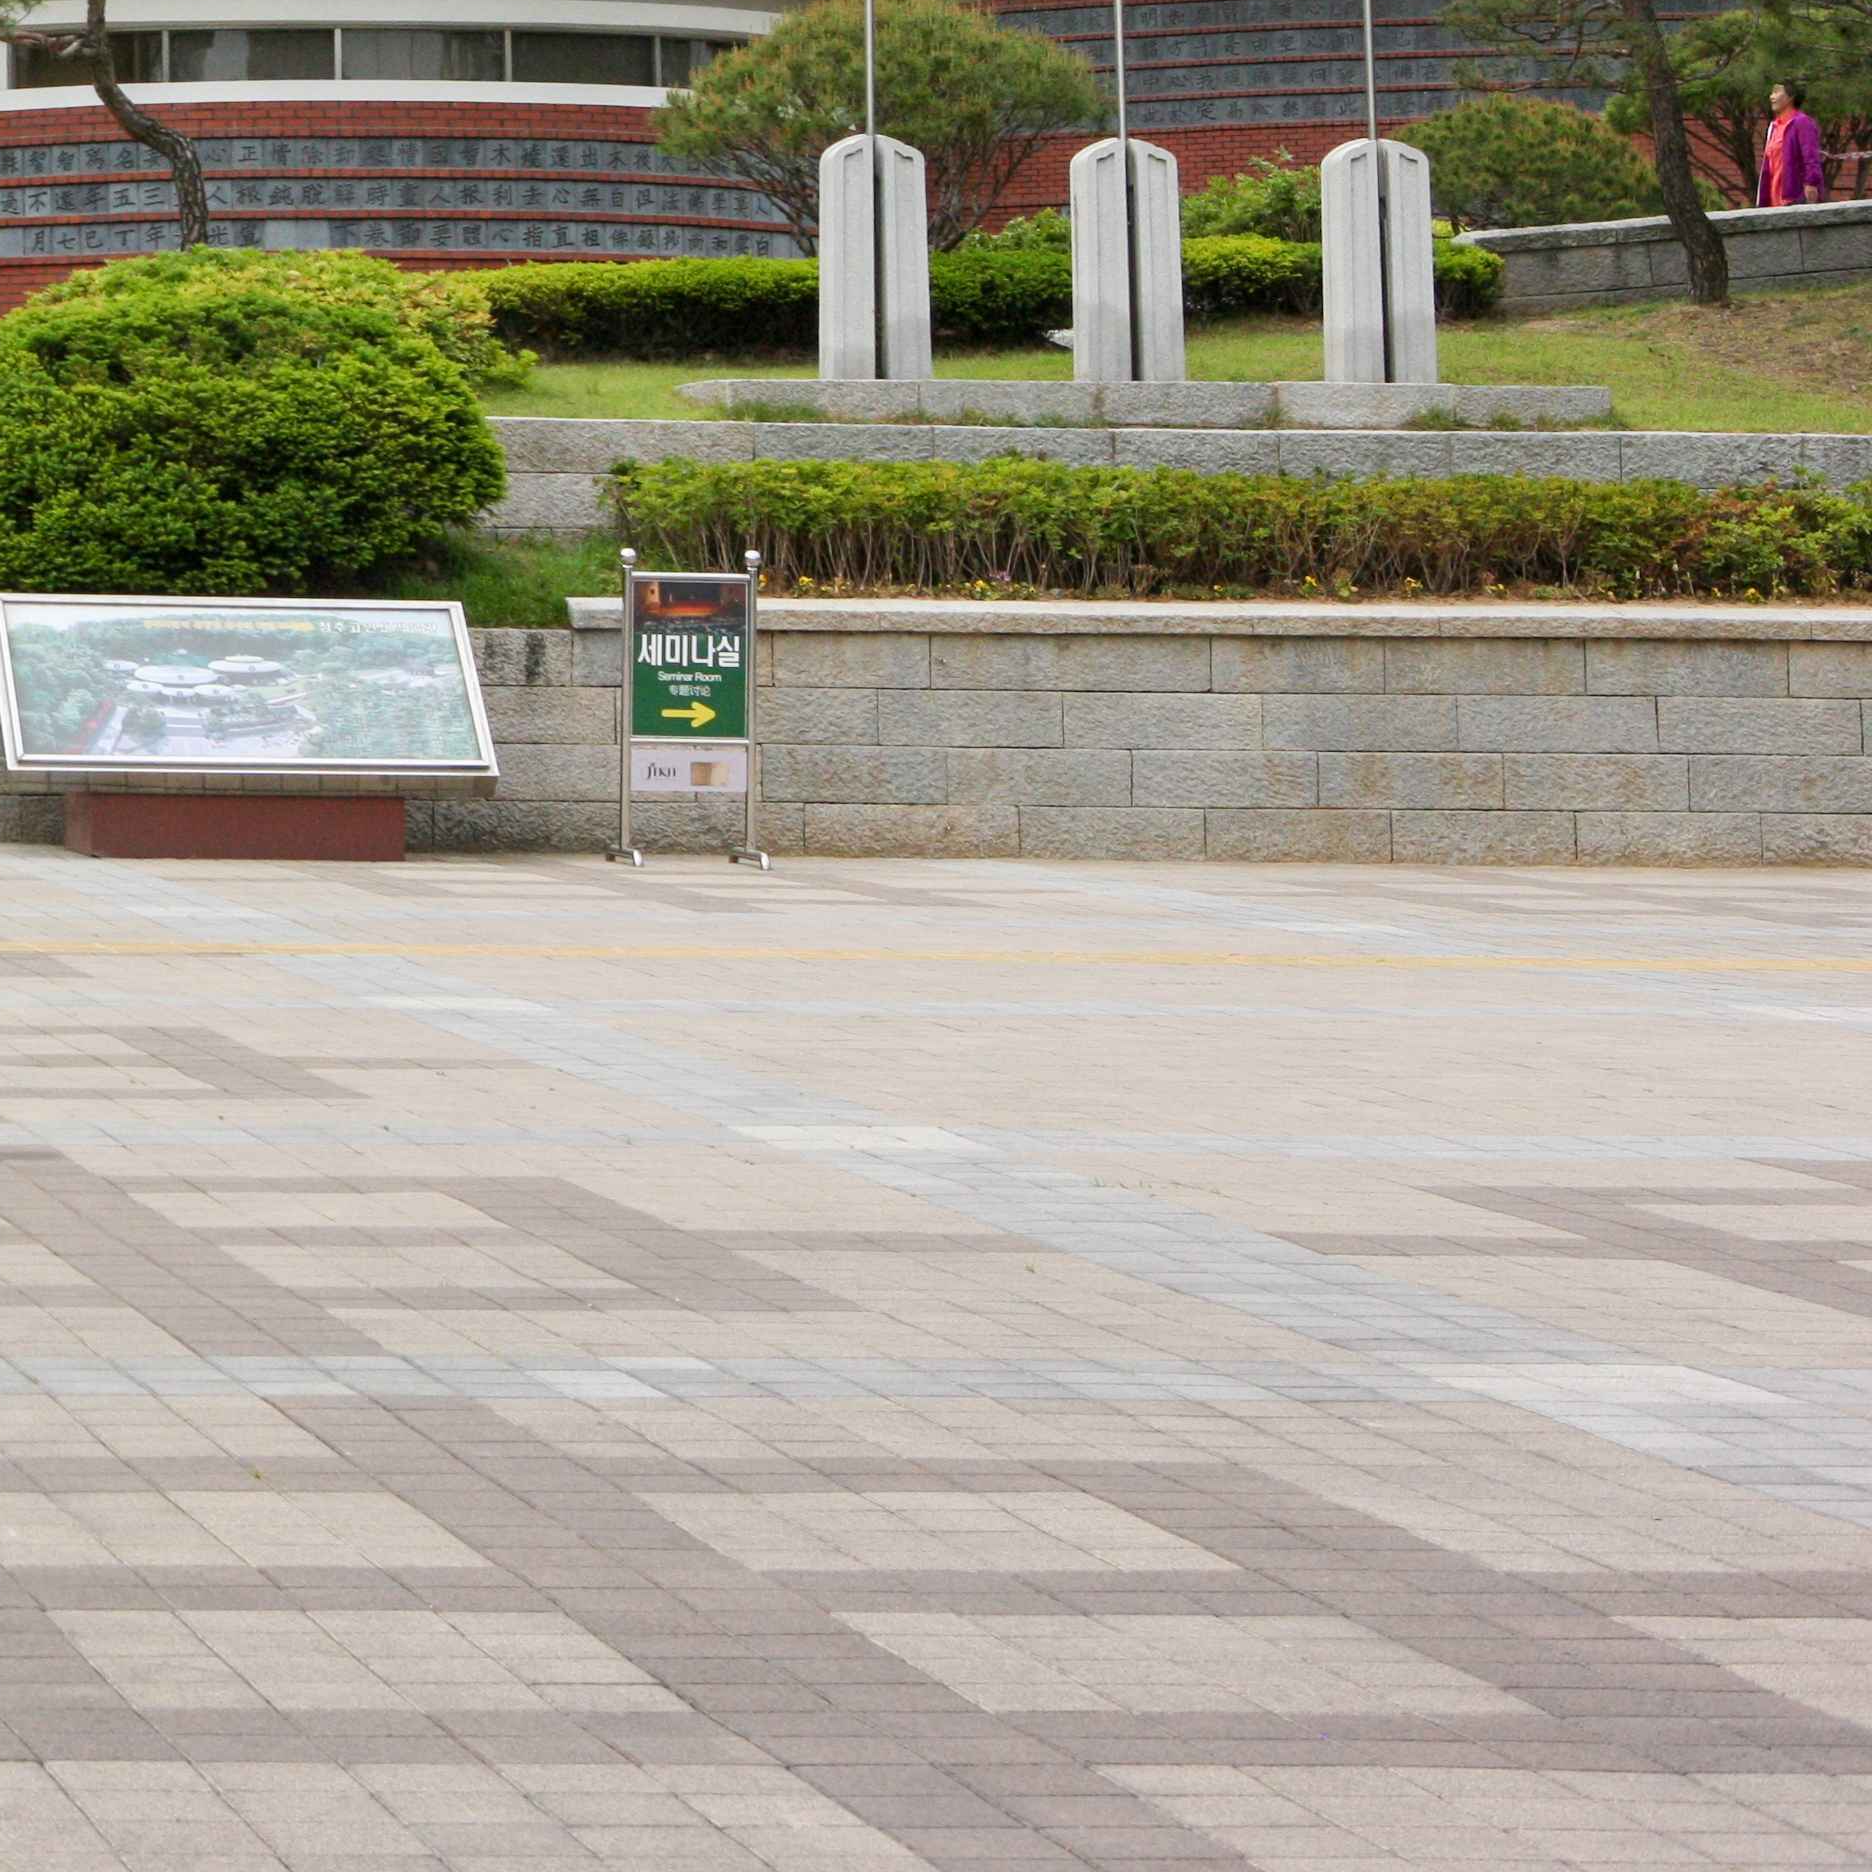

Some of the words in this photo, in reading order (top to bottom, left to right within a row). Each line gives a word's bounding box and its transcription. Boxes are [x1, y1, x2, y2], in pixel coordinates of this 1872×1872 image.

[637, 634, 740, 667] 세미나실
[657, 671, 693, 682] Seminar
[695, 672, 722, 682] Room
